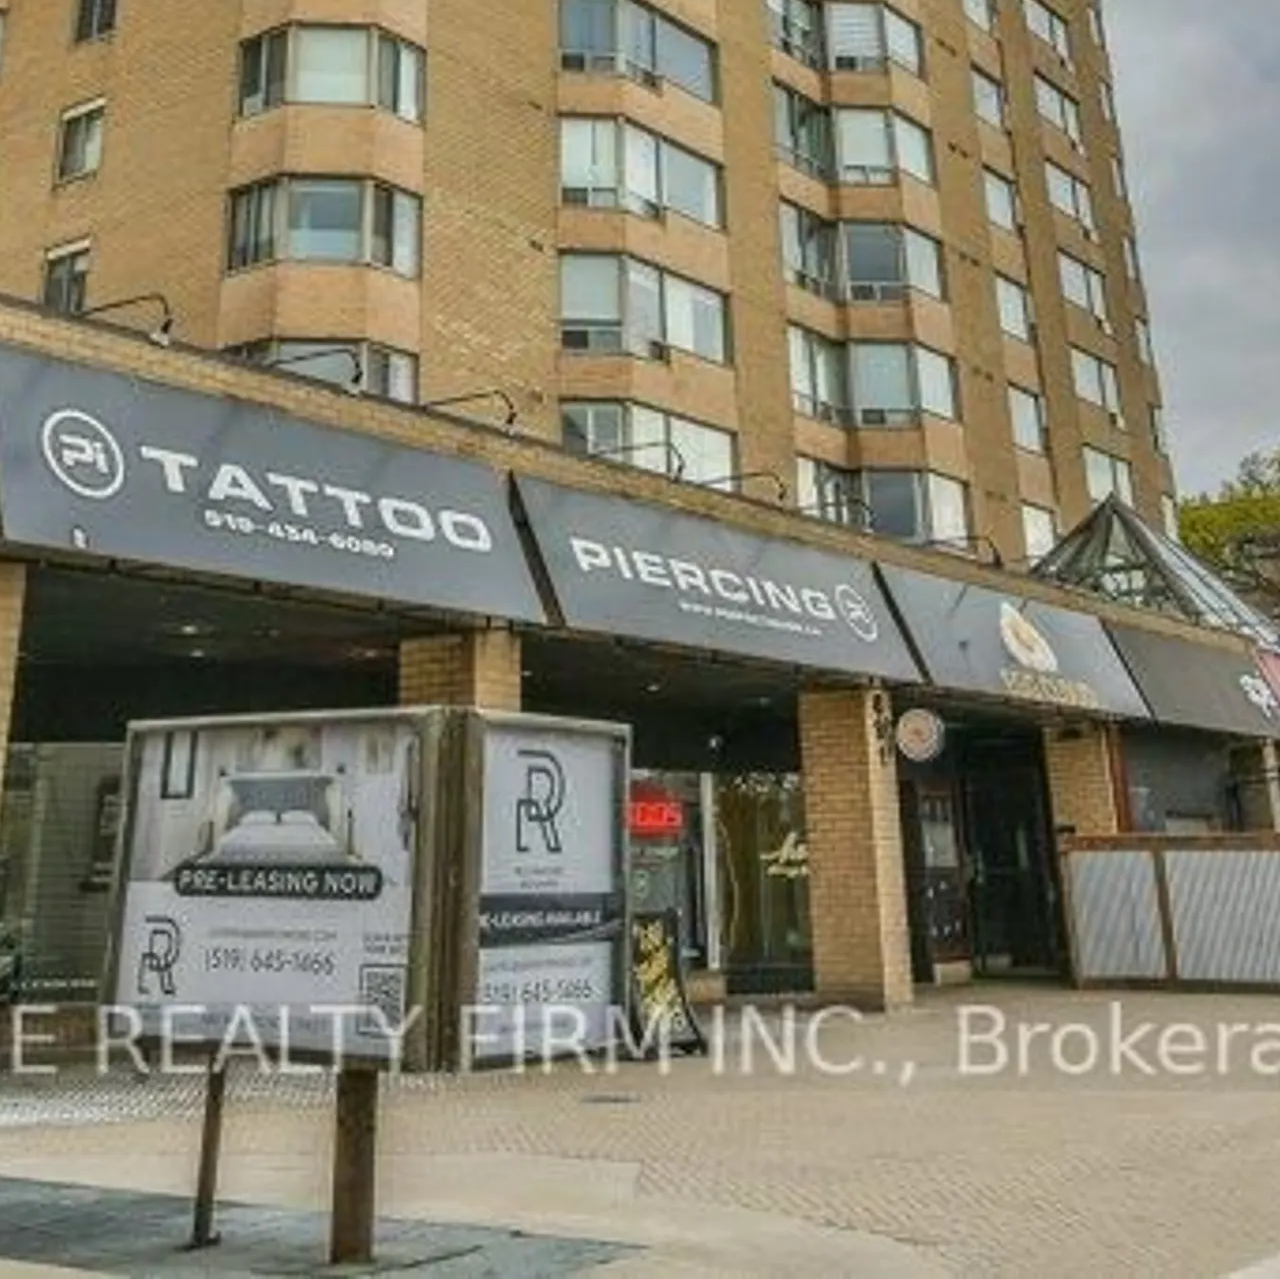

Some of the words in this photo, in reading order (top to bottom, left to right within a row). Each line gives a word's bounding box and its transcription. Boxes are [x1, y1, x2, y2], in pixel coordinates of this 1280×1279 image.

[140, 444, 493, 553] TATTOO
[570, 536, 837, 620] PIERCING
[178, 870, 320, 894] PRE-LEASING
[322, 870, 376, 895] NOW
